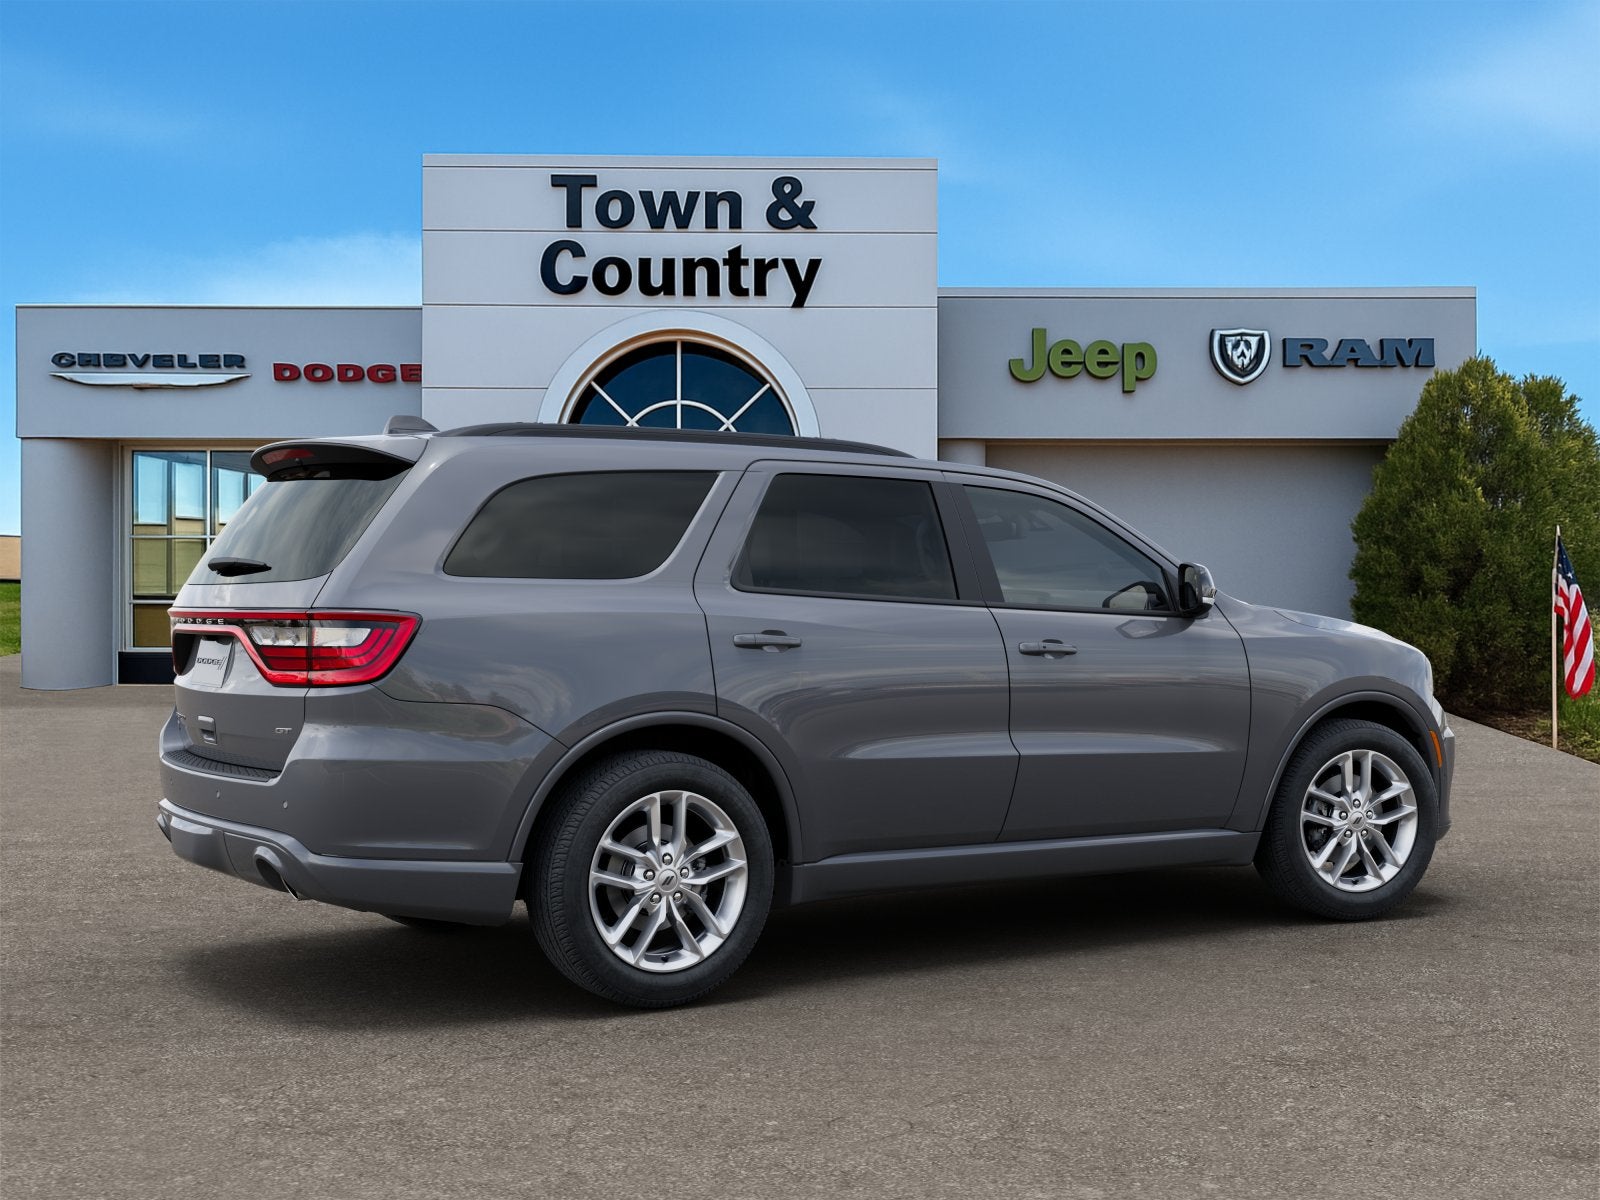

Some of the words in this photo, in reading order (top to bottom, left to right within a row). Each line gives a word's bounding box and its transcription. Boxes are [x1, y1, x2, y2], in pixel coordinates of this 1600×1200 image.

[551, 174, 742, 229] Town
[765, 176, 818, 230] &
[540, 240, 822, 308] Country
[273, 363, 422, 382] DODGE
[1009, 328, 1157, 392] Jeep
[1282, 337, 1435, 367] RAM
[274, 727, 293, 736] GT
